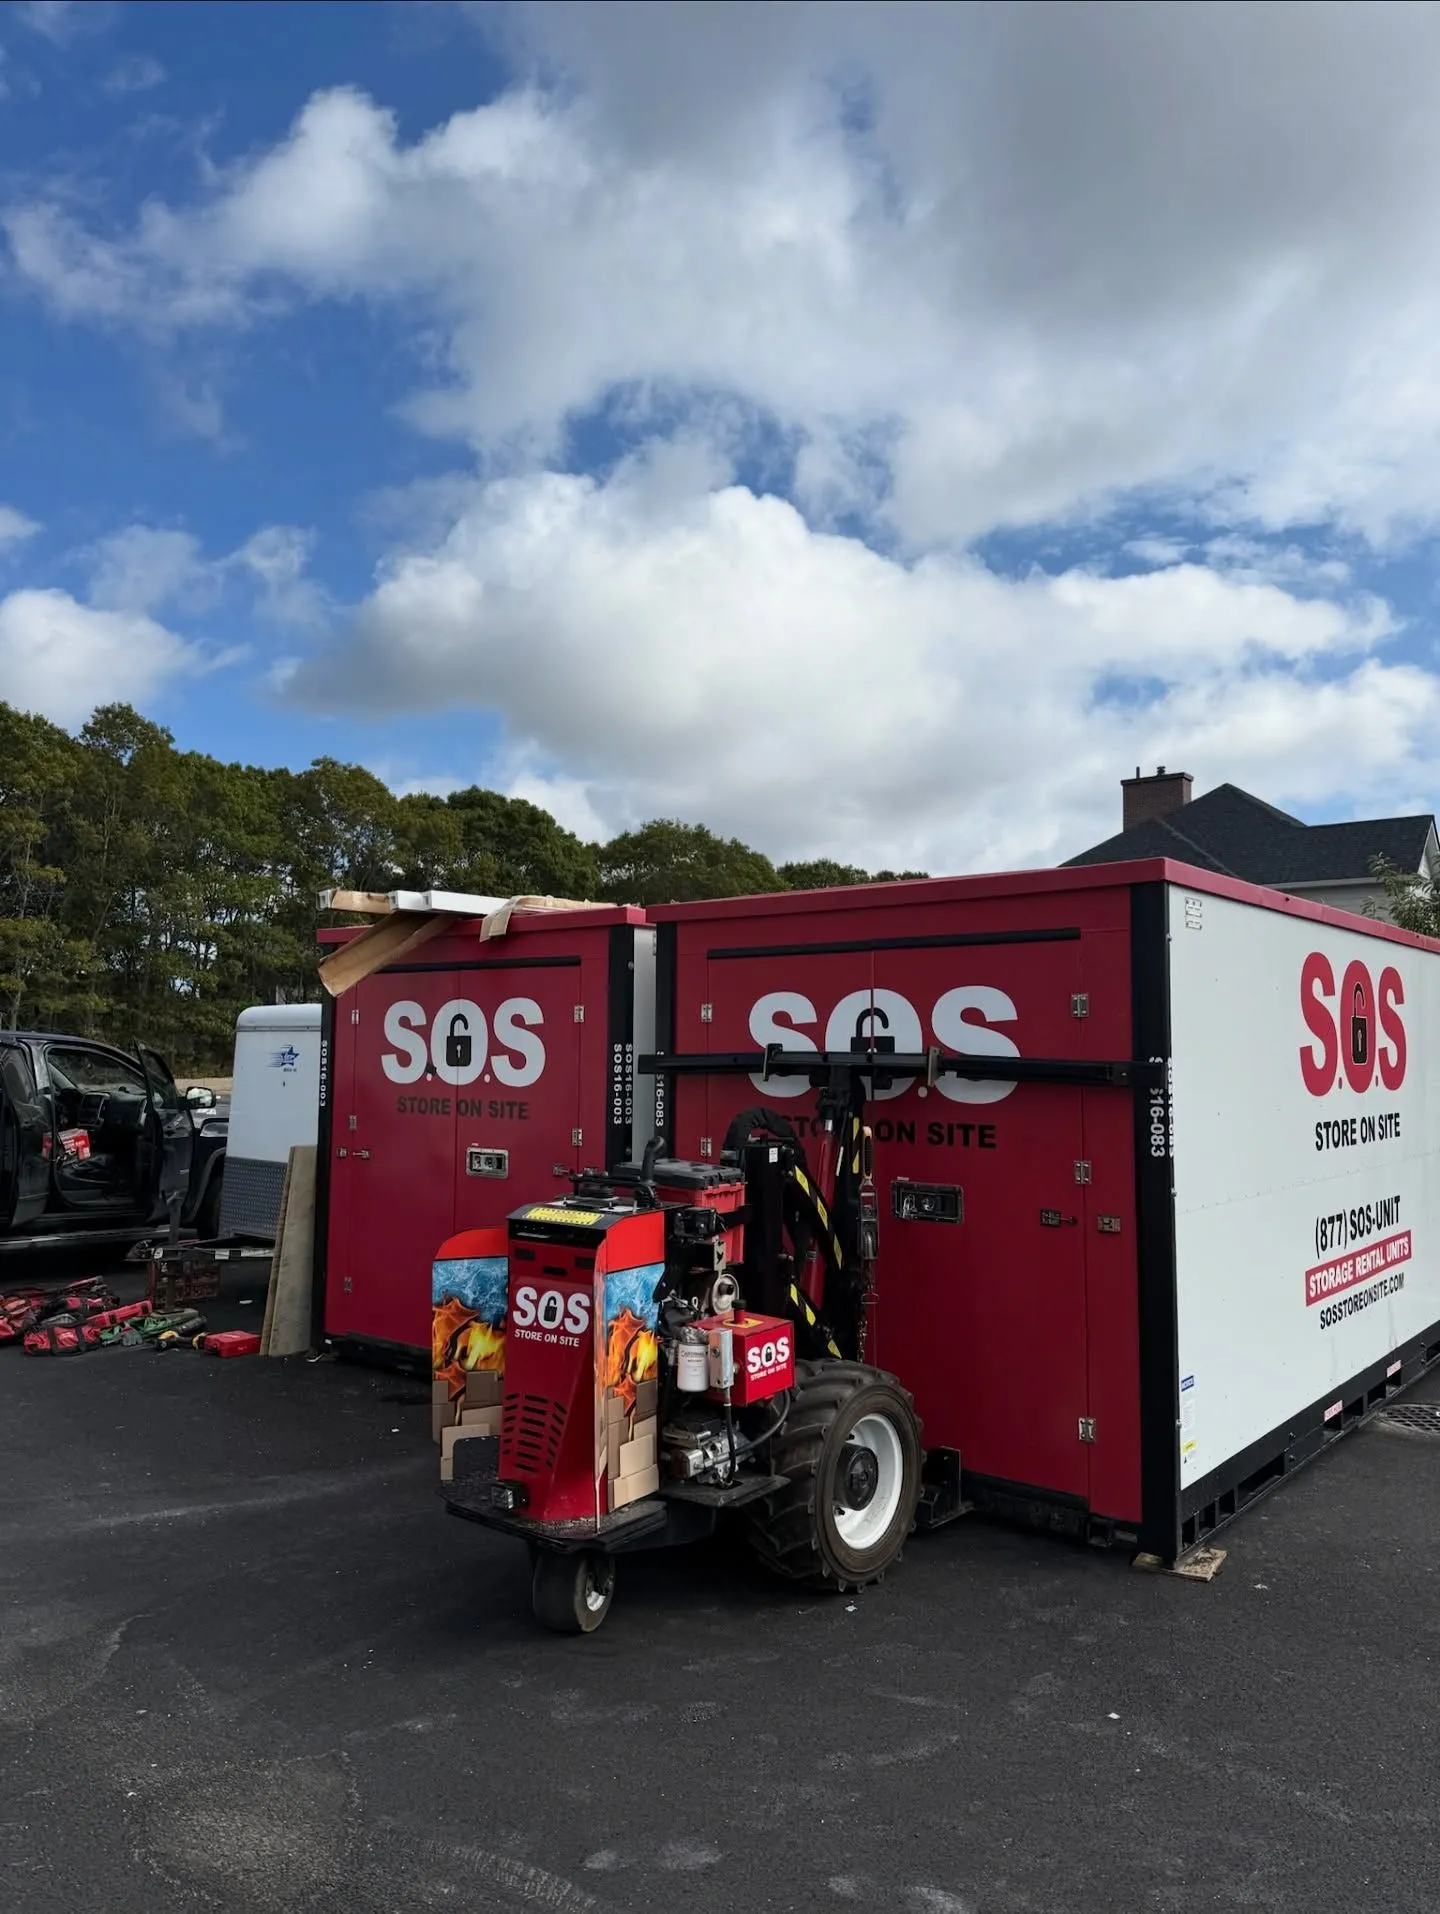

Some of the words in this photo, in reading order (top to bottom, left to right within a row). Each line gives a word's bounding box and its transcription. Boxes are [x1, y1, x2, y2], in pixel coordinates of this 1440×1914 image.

[1300, 951, 1407, 1096] S.O.S
[397, 1096, 451, 1116] STORE
[457, 1099, 482, 1117] ON
[488, 1099, 529, 1120] SITE
[613, 1043, 623, 1125] SOS16-003
[624, 1043, 633, 1125] SOS16-003
[655, 1050, 665, 1127] SS16-083
[1148, 1056, 1166, 1157] SS16-083
[874, 1119, 916, 1144] ON
[927, 1121, 996, 1149] SITE
[1315, 1118, 1357, 1151] STORE
[1360, 1115, 1376, 1144] ON
[1378, 1112, 1400, 1141] SITE
[1315, 1208, 1348, 1260] (877)
[1350, 1195, 1400, 1241] SOS-UNIT
[1309, 1259, 1354, 1298] STORAGE
[1355, 1246, 1386, 1278] RENTAL
[1386, 1236, 1409, 1263] UNITS
[513, 1286, 591, 1334] S.O.S
[1320, 1272, 1404, 1330] SOSSTOREONSITE.COM
[514, 1329, 542, 1342] STORE
[544, 1333, 557, 1344] ON
[559, 1335, 580, 1347] SITE
